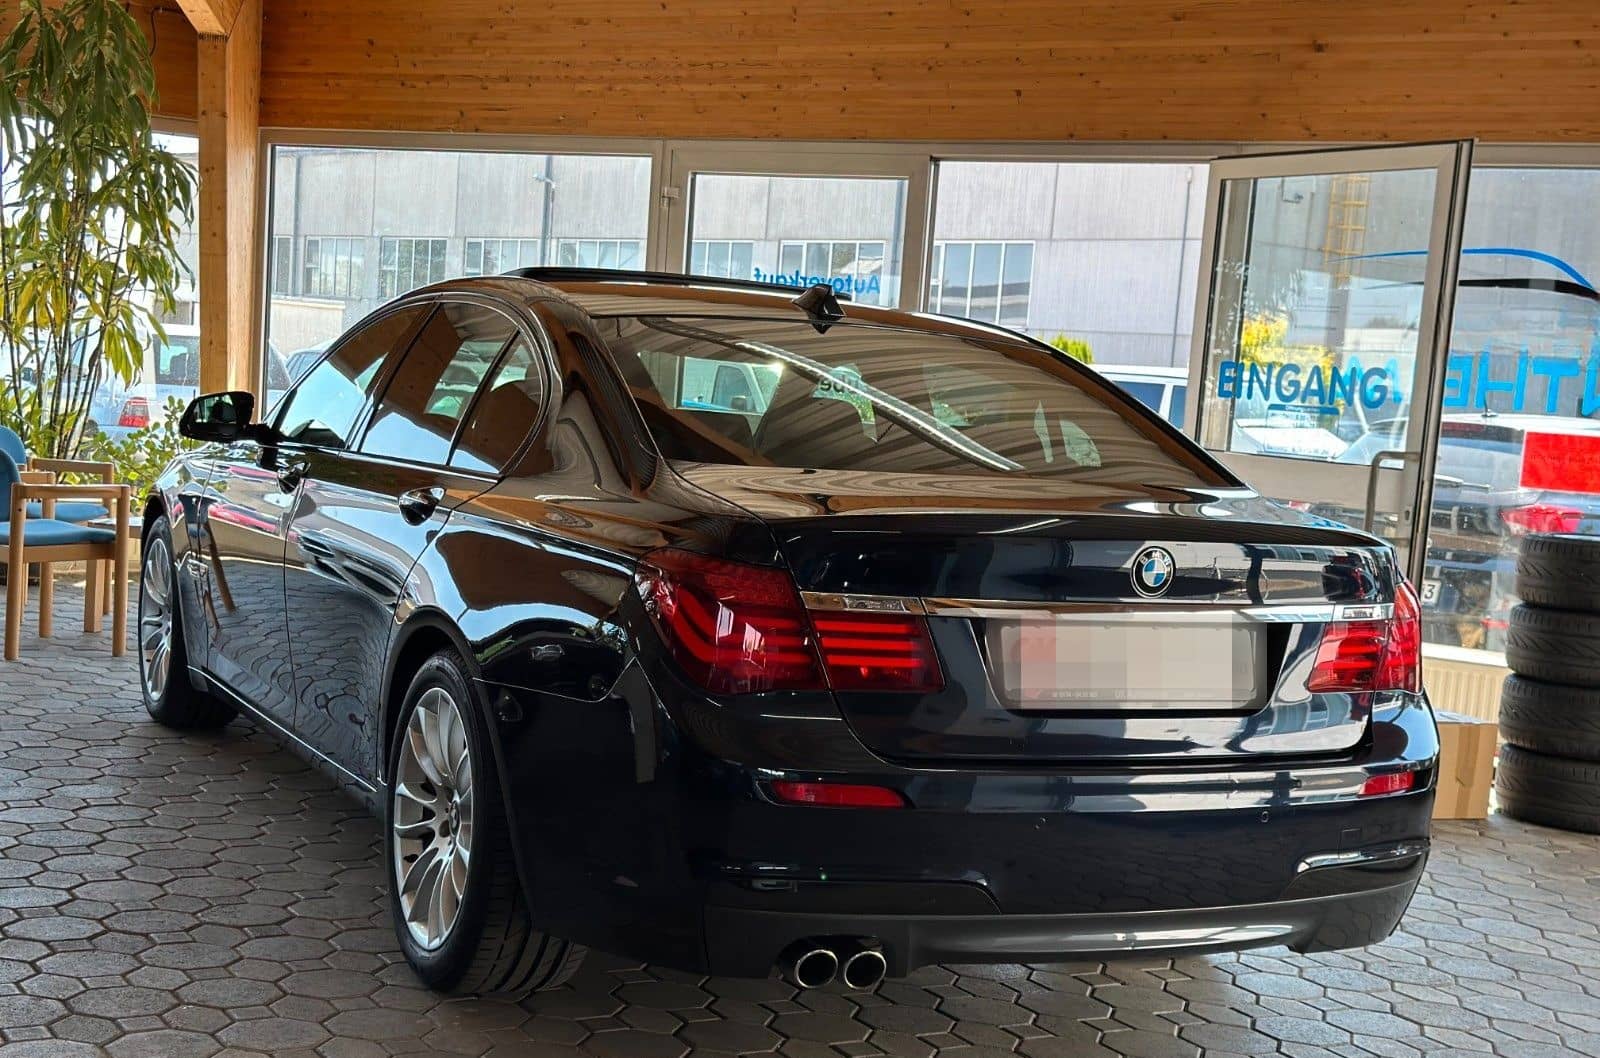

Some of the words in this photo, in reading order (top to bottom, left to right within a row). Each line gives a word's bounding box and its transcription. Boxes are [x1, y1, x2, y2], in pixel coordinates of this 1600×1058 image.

[1217, 360, 1388, 409] EINGANG
[1139, 550, 1172, 566] BMW
[1422, 583, 1436, 599] 3
